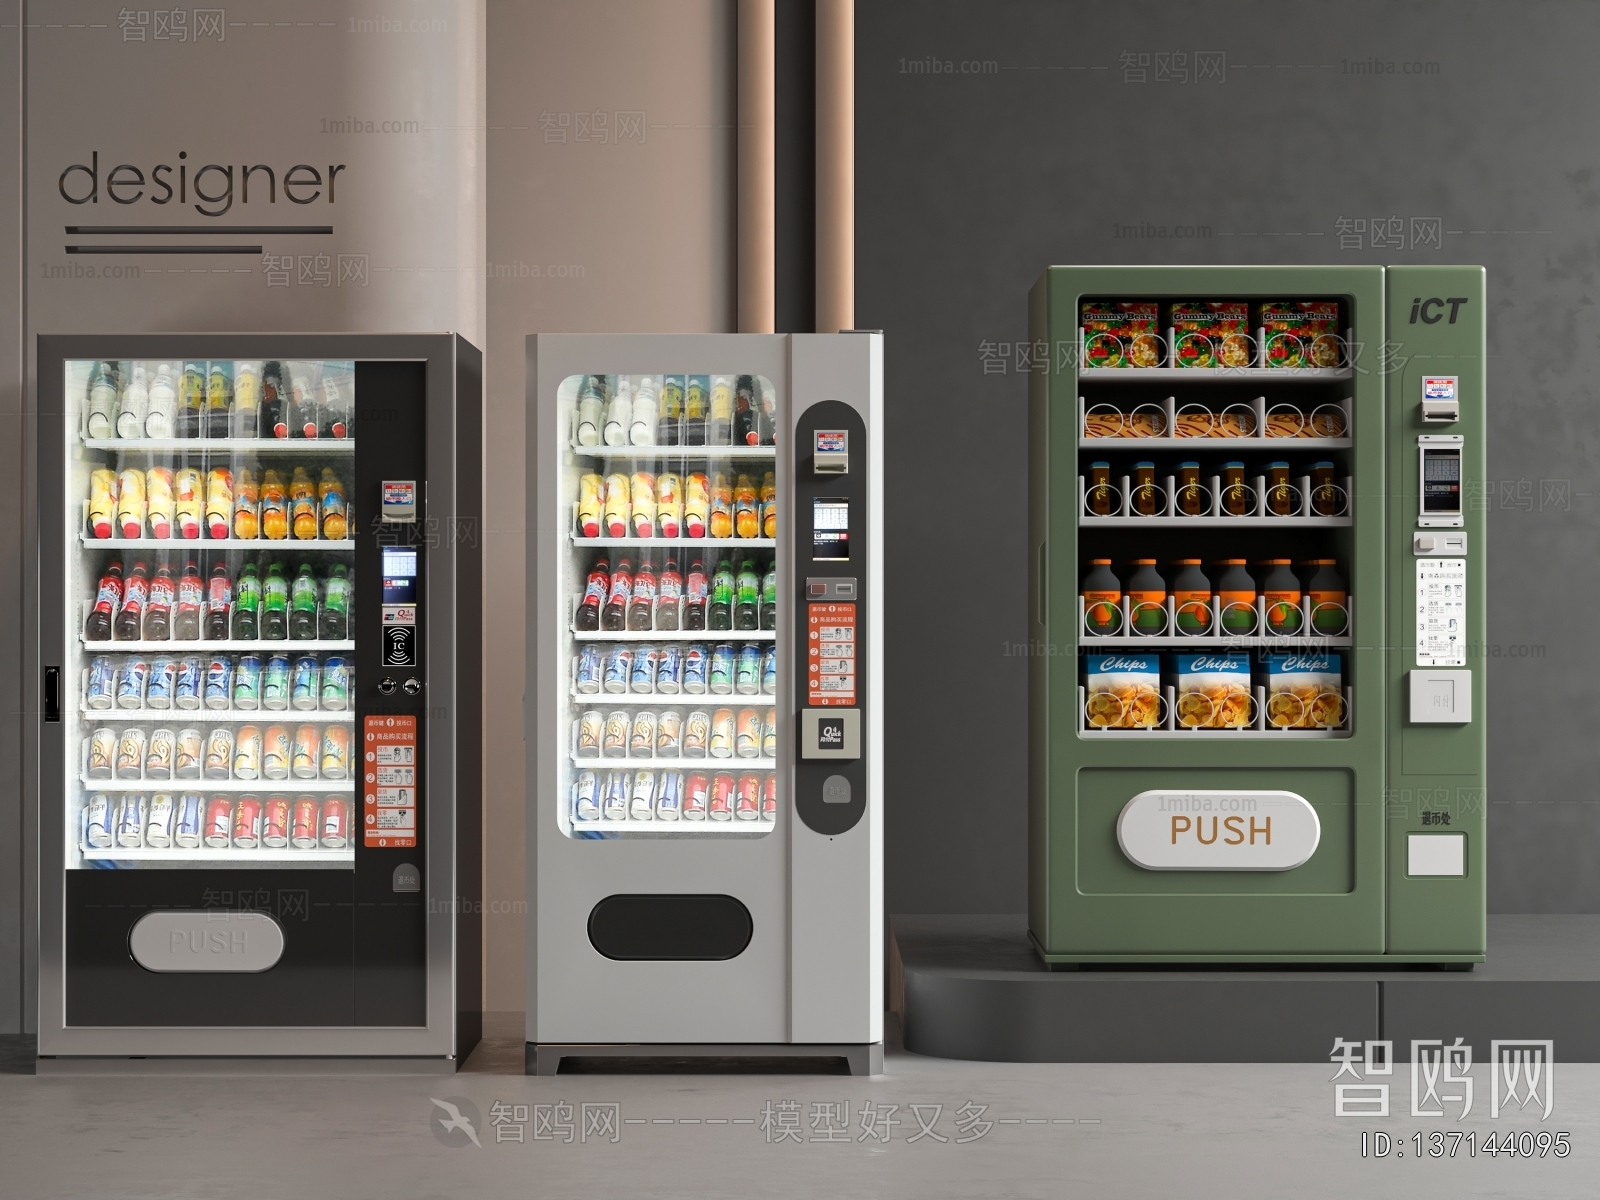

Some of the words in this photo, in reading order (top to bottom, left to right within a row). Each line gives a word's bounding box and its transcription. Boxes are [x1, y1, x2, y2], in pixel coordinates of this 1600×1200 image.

[58, 151, 347, 217] designer
[1084, 312, 1124, 321] Gummy
[1126, 312, 1156, 320] Bears
[1174, 312, 1214, 321] Gummy
[1216, 312, 1246, 320] Bears
[1264, 312, 1304, 321] Gummy
[1306, 312, 1336, 320] Bears
[1408, 297, 1469, 325] iCT
[393, 642, 405, 650] IC
[1100, 656, 1148, 673] Chips
[1190, 656, 1239, 673] Chips
[1281, 656, 1330, 673] Chips
[376, 732, 414, 740] 商品购买流程
[1422, 811, 1451, 826] 退币处
[1170, 815, 1272, 846] PUSH
[168, 929, 249, 954] PUSH
